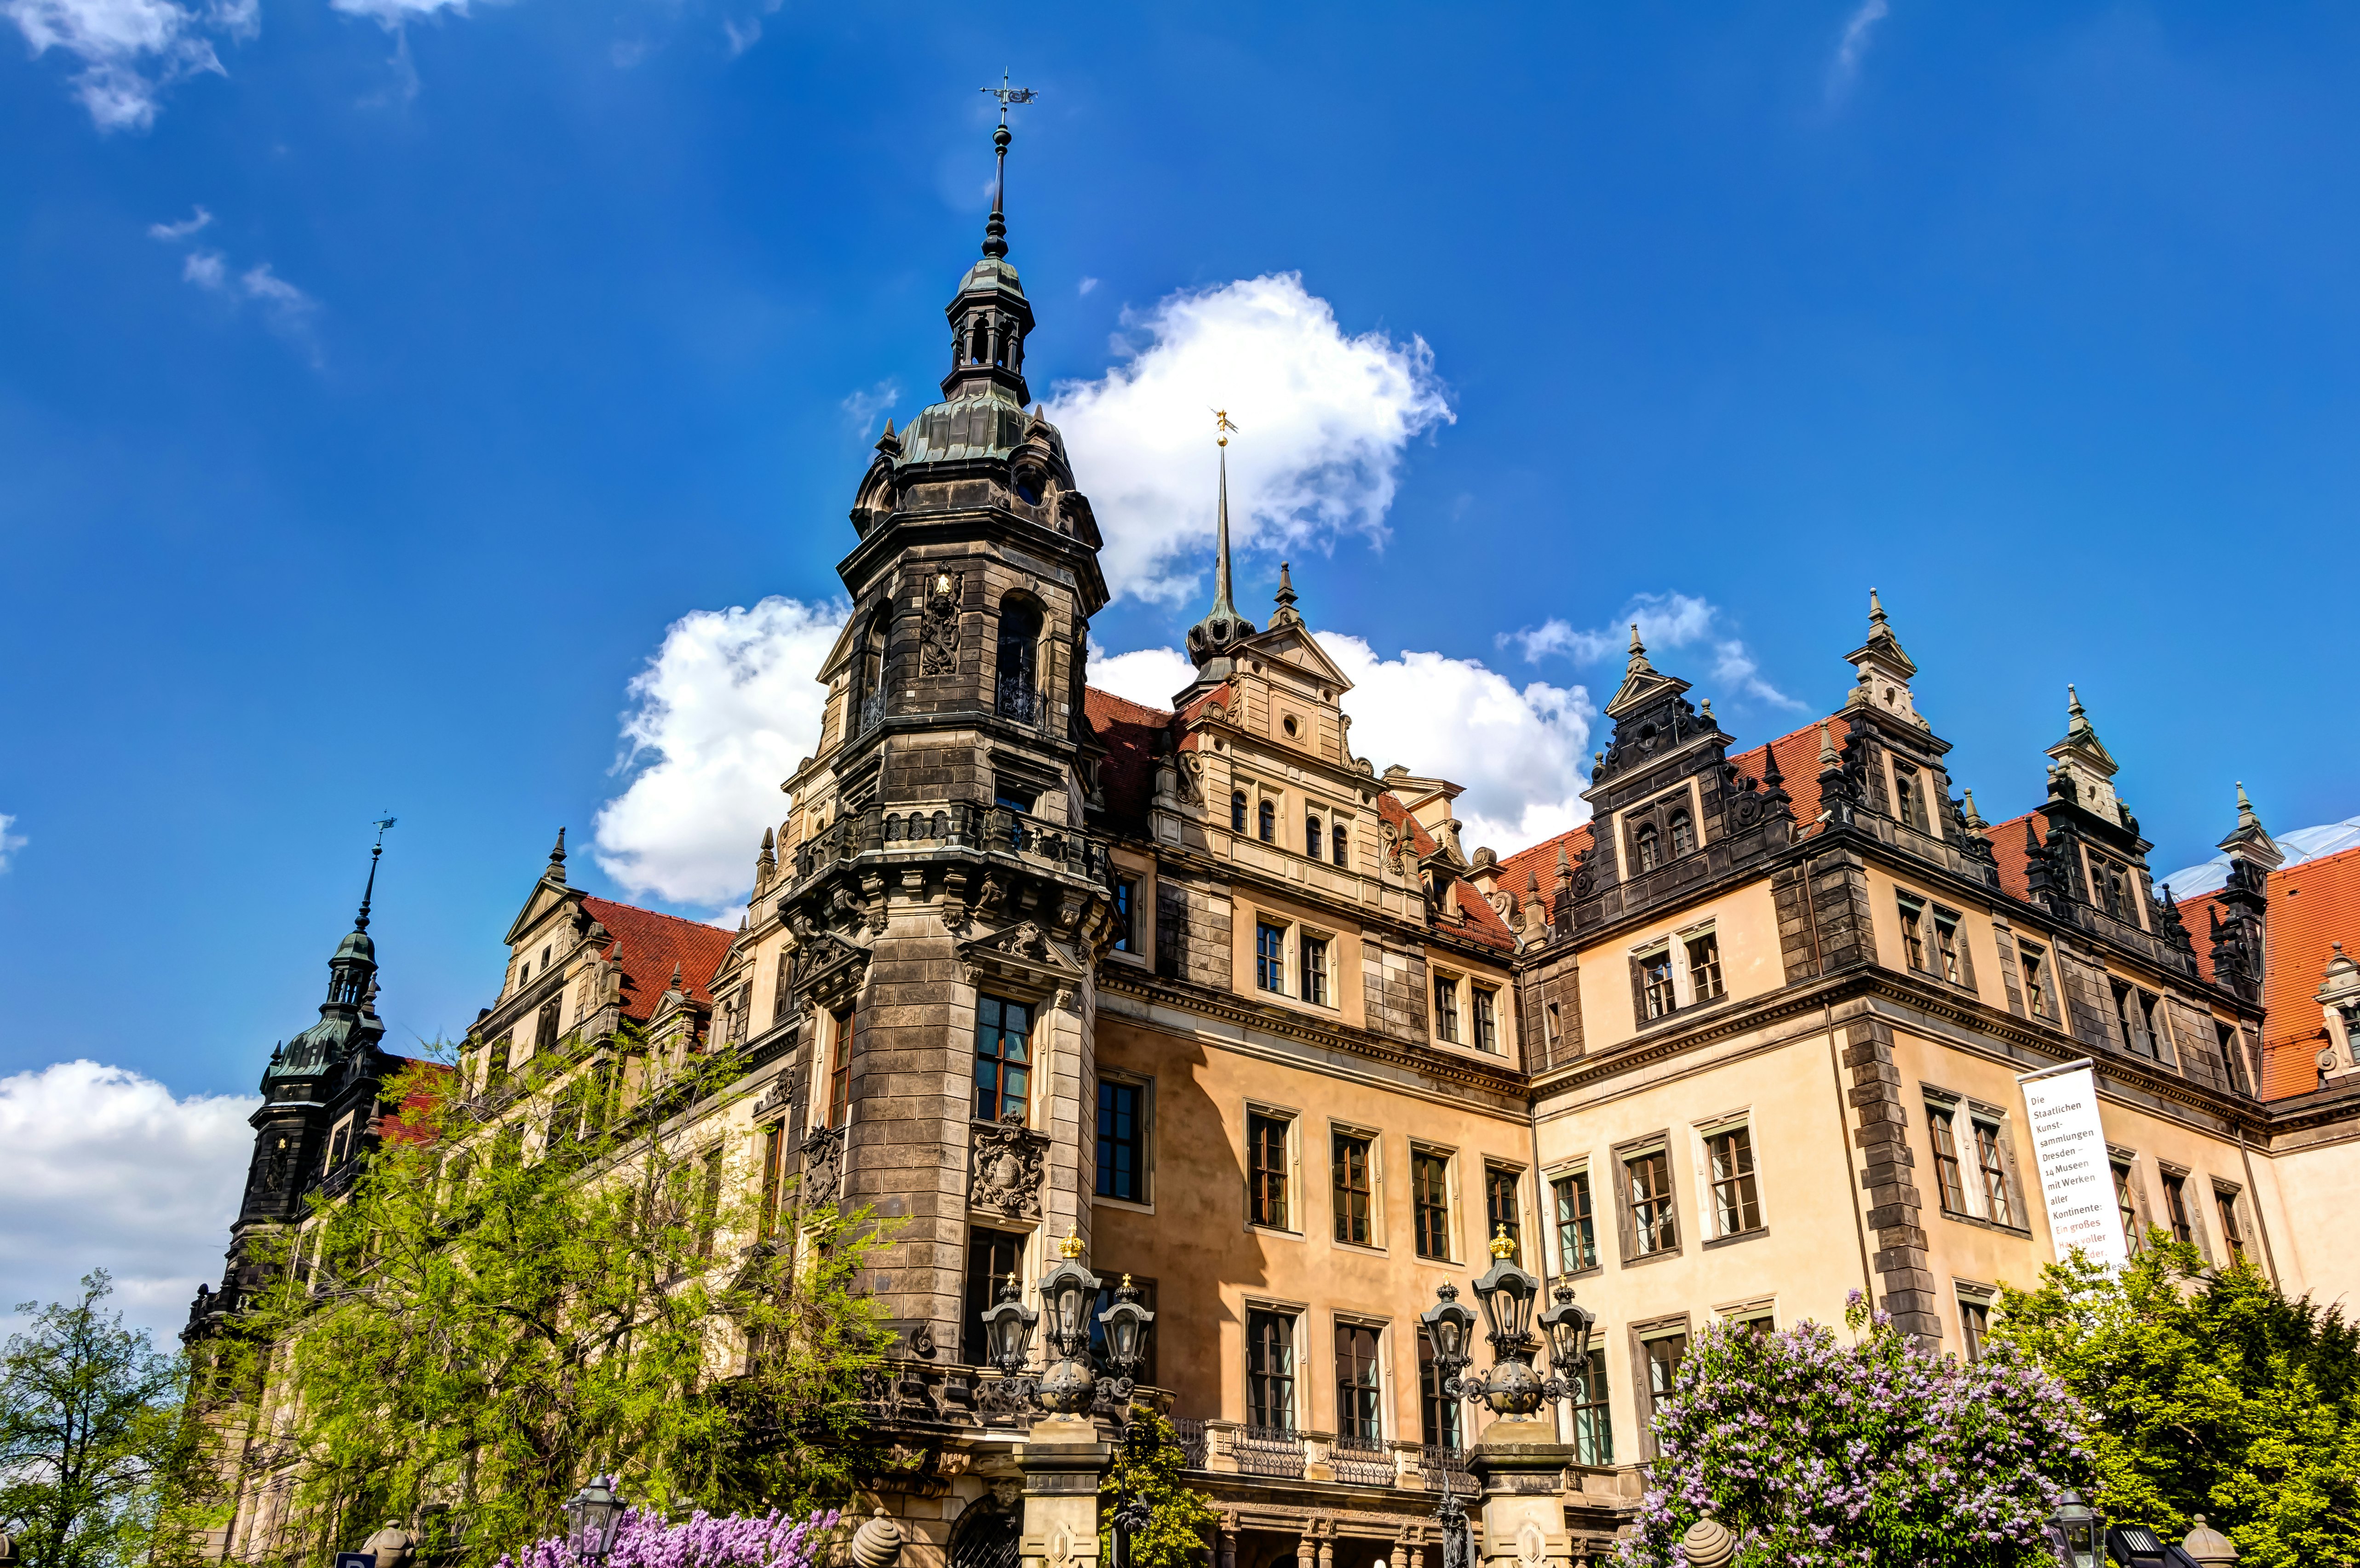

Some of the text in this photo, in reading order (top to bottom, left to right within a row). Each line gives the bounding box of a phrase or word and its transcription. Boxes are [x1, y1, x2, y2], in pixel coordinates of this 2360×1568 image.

[2031, 1097, 2044, 1105] Die
[2034, 1103, 2081, 1119] Staatlichen
[2036, 1122, 2063, 1133] Kunst-
[2040, 1130, 2094, 1148] sammlungen
[2043, 1149, 2075, 1162] Dresden
[2056, 1161, 2089, 1173] Museen
[2048, 1175, 2096, 1190] mit Werken
[2050, 1196, 2068, 1205] aller
[2053, 1204, 2102, 1219] Kontinente:
[2056, 1220, 2101, 1234] Ein großes
[2059, 1234, 2106, 1249] Haus voller
